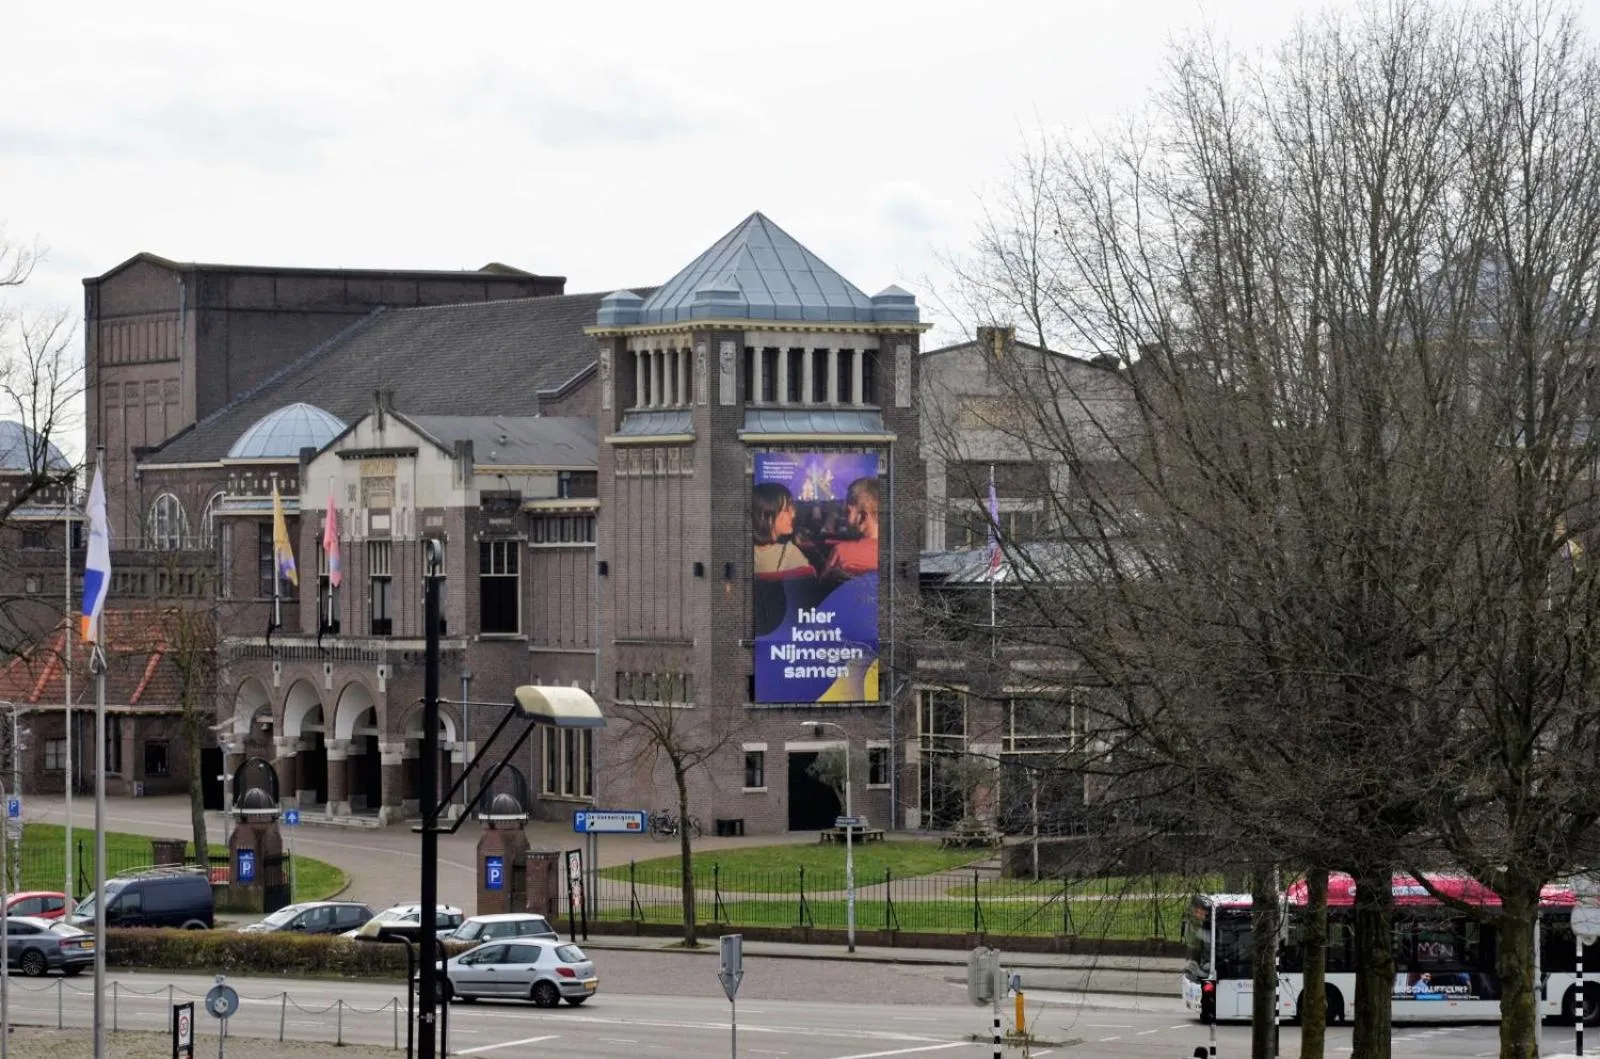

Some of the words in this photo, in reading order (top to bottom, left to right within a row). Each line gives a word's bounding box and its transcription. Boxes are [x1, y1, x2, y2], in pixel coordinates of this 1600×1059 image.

[798, 607, 836, 623] hier
[792, 627, 842, 641] komt
[771, 644, 862, 663] Nijmegen
[784, 666, 849, 678] samen
[576, 813, 585, 825] P
[243, 862, 251, 875] P
[491, 870, 500, 882] P
